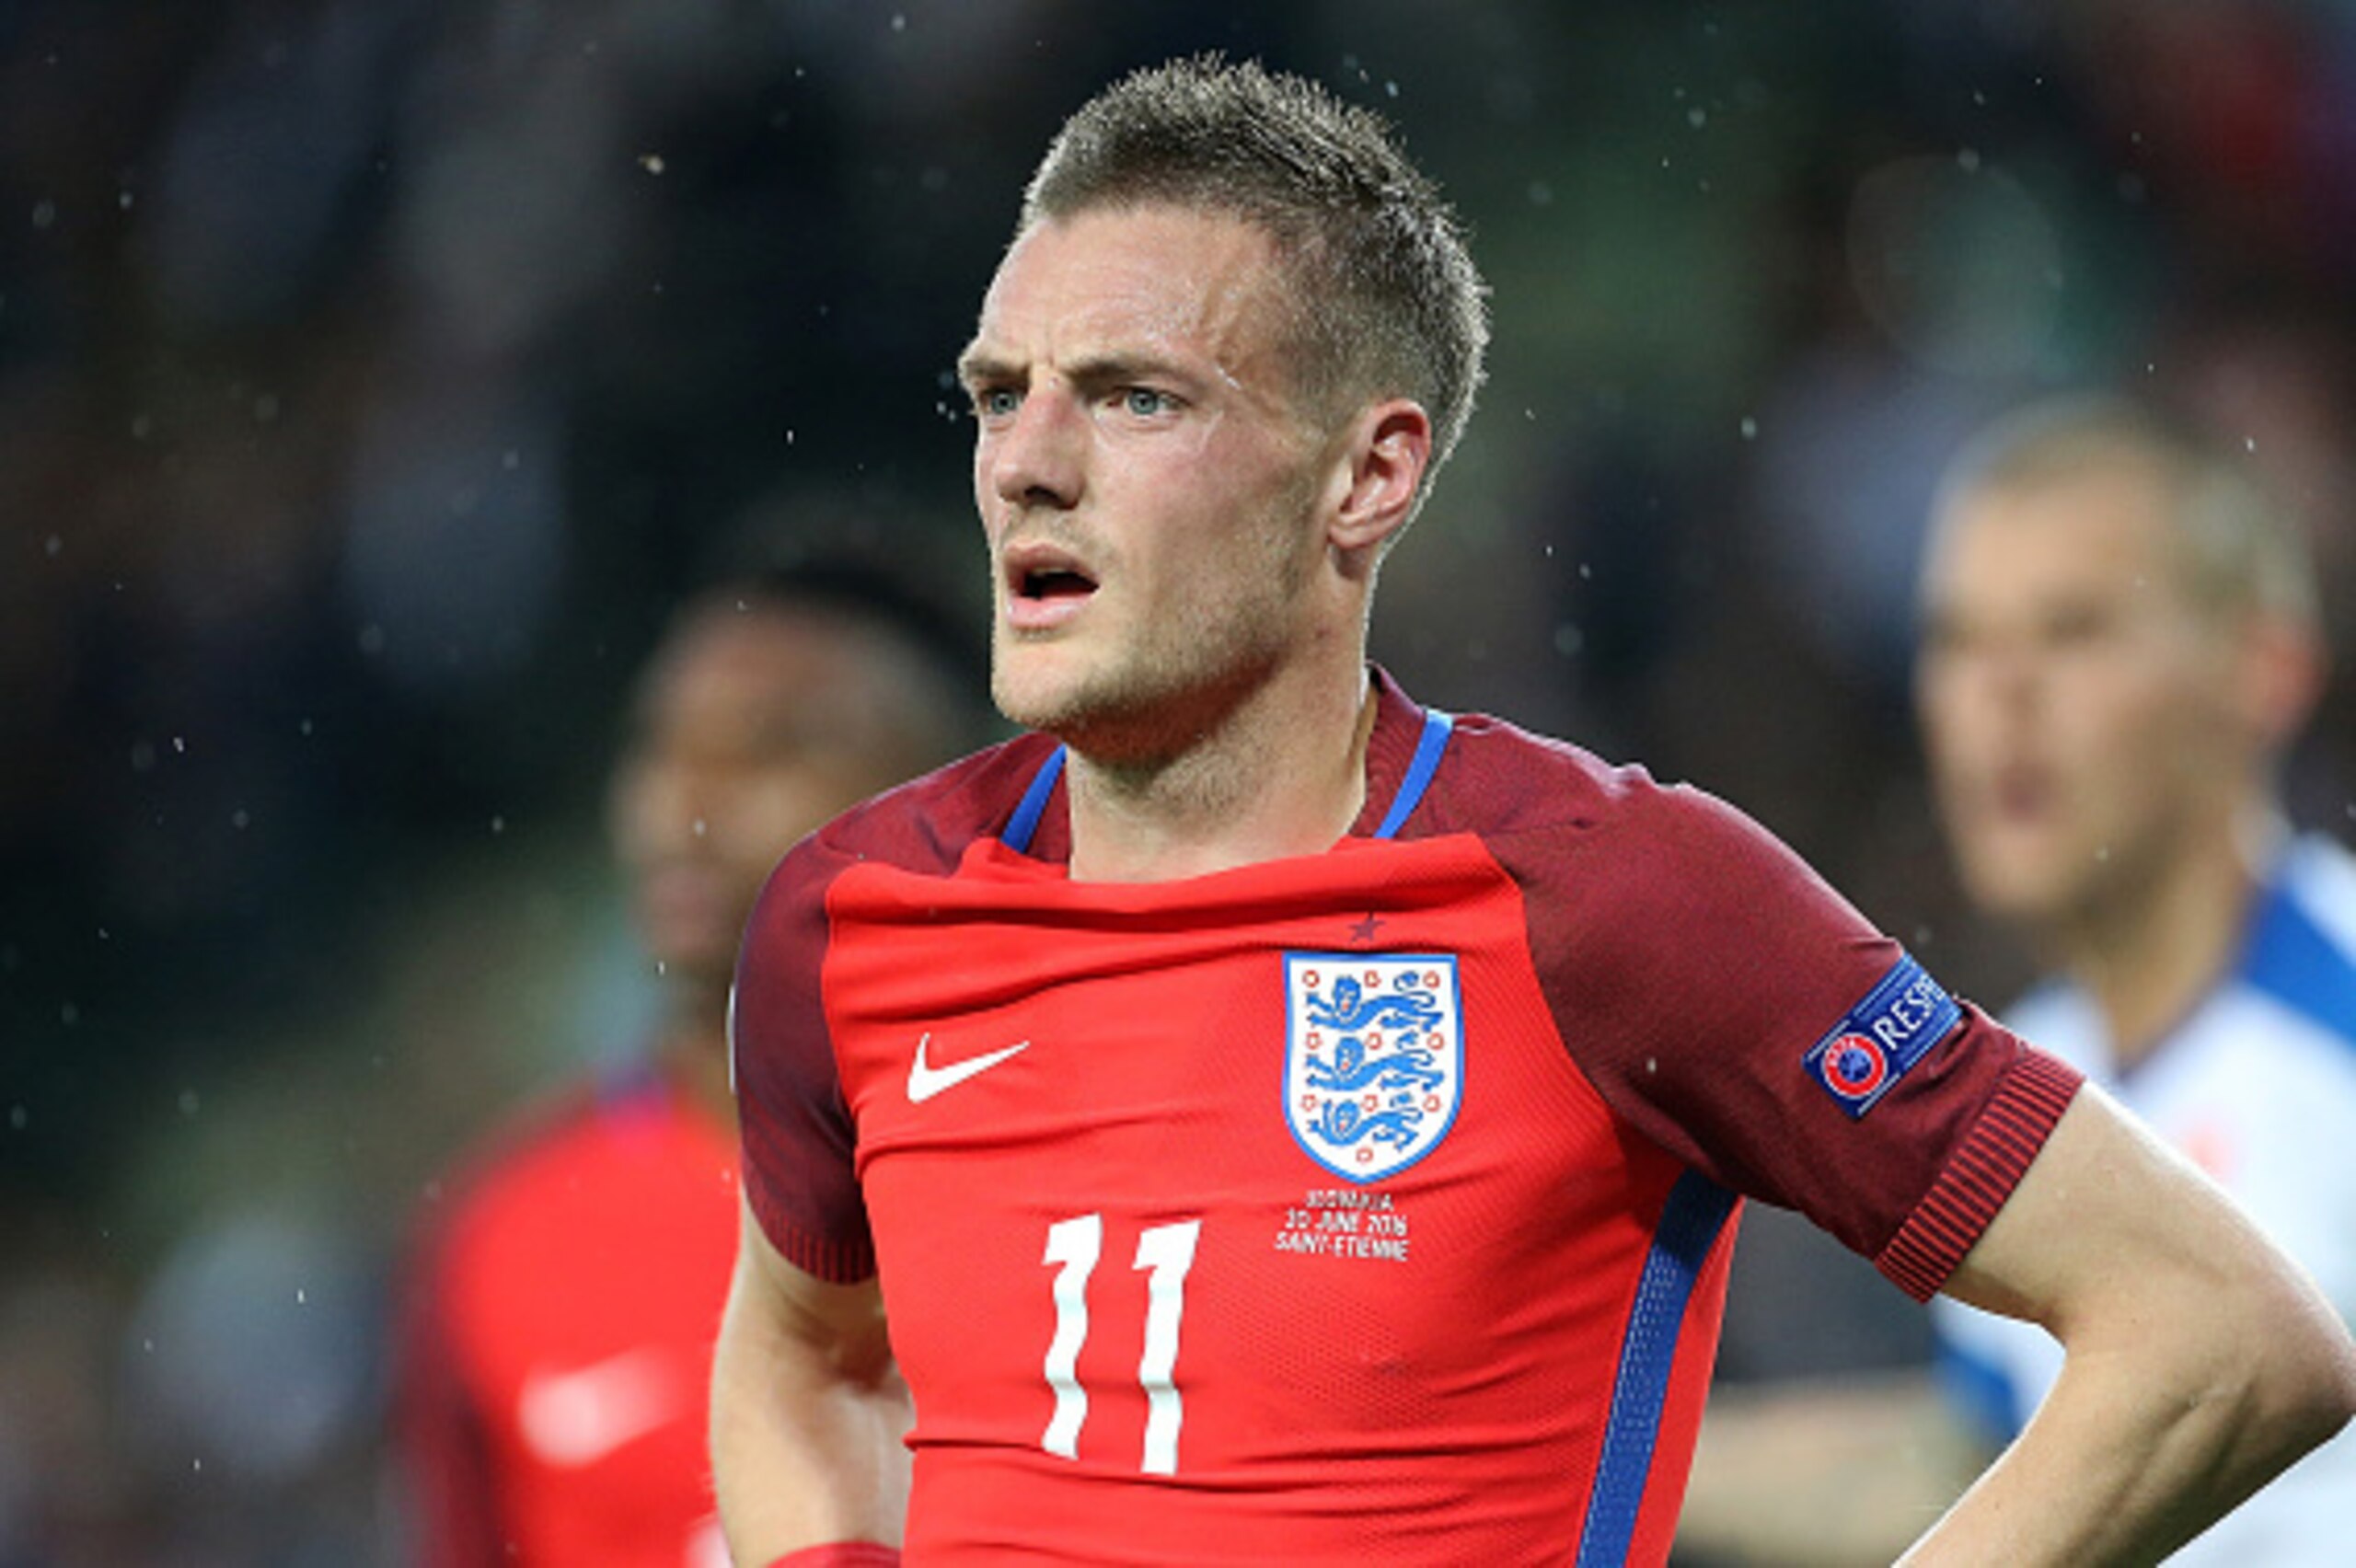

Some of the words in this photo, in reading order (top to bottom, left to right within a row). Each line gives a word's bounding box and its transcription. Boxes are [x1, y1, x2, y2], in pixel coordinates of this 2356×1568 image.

[1316, 1211, 1360, 1232] JUNE
[1368, 1215, 1408, 1236] 2016
[1041, 1212, 1203, 1476] 11
